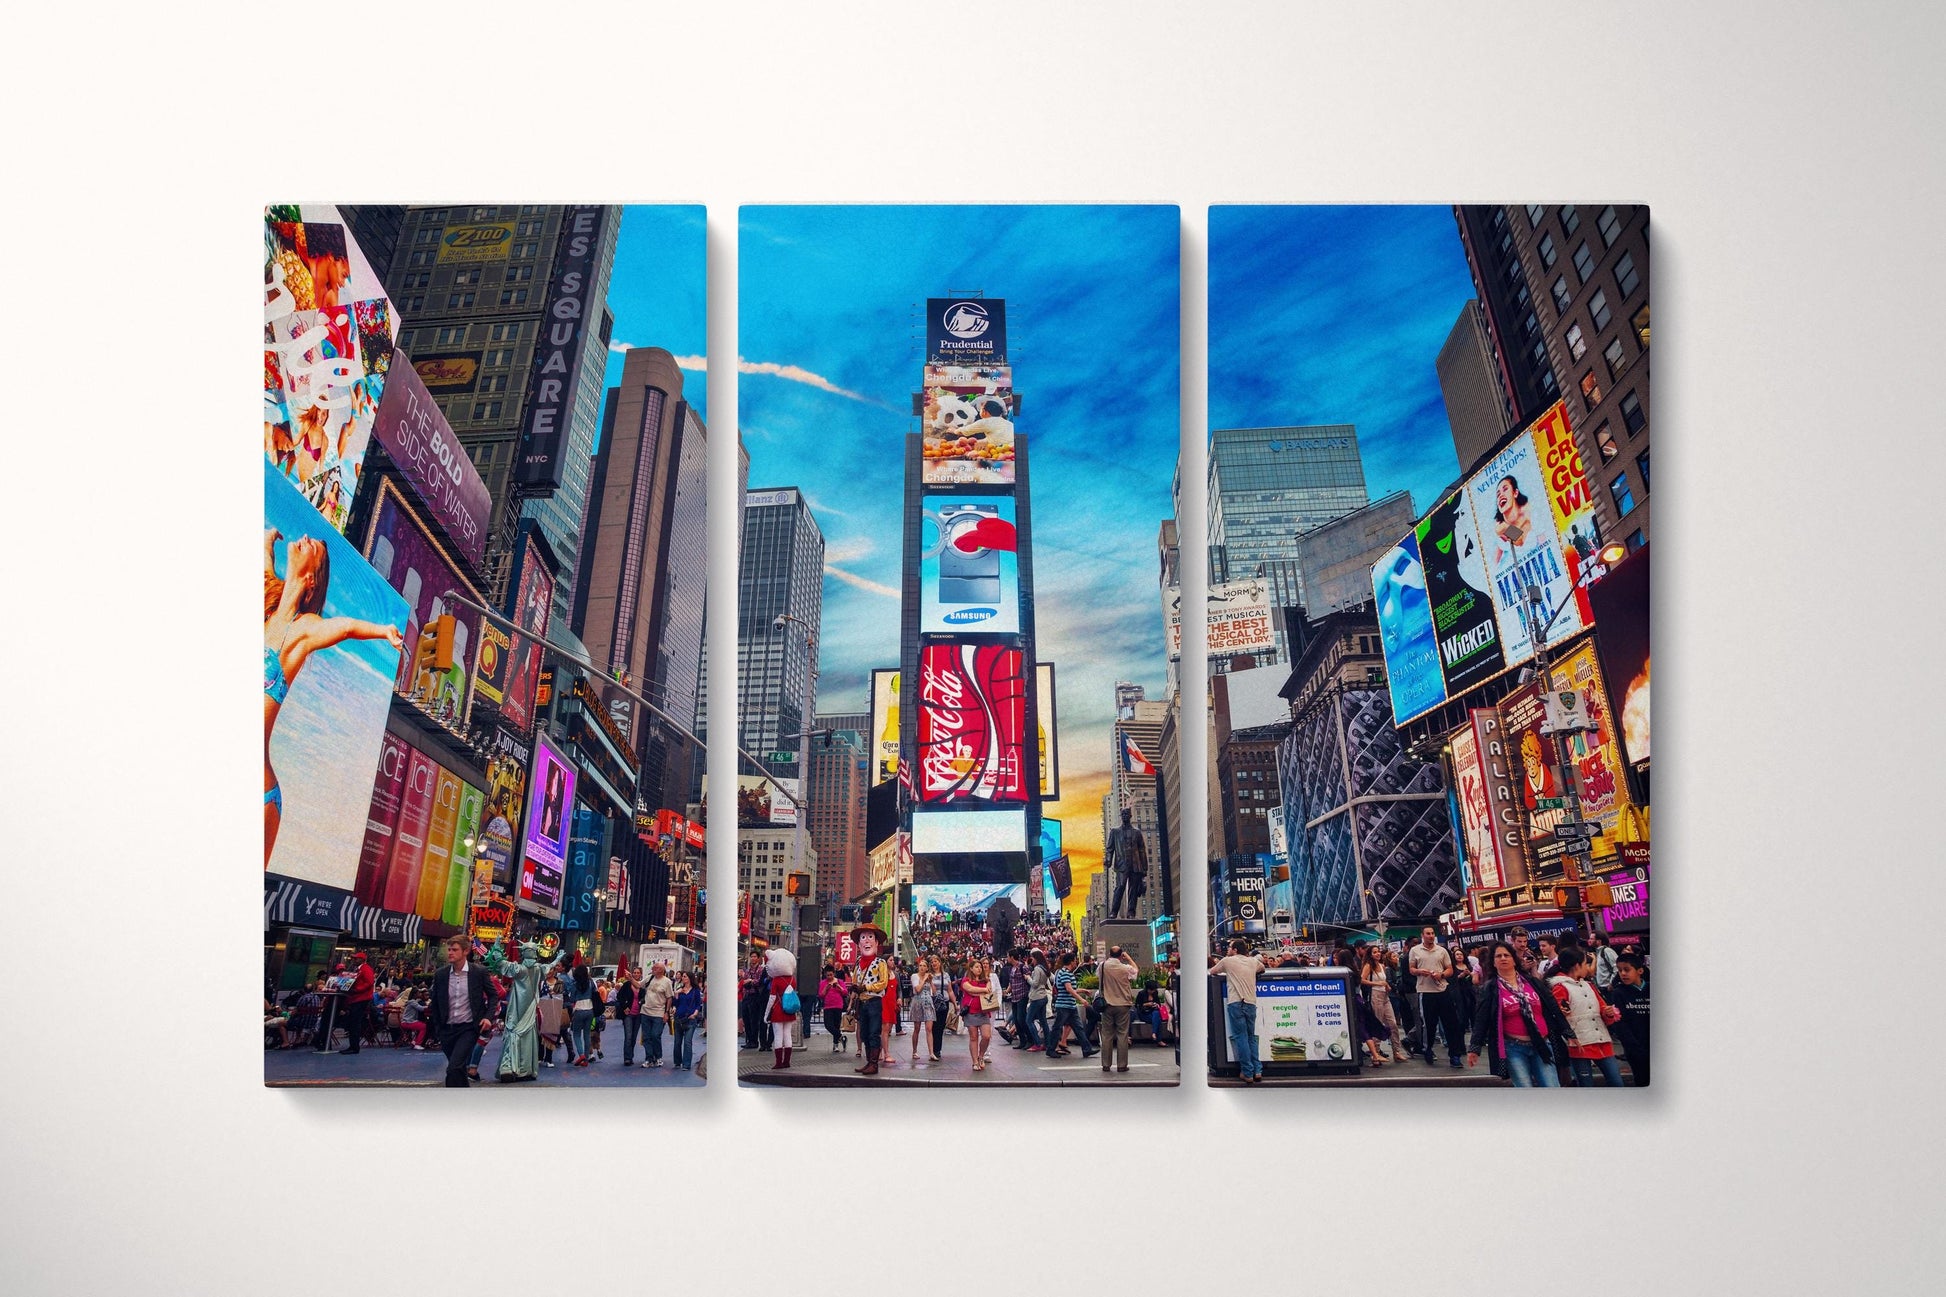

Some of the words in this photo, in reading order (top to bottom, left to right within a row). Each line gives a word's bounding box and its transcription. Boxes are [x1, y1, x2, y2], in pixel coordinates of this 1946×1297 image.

[450, 228, 505, 247] Z100
[568, 205, 599, 257] ES
[940, 339, 993, 349] Prudential
[532, 272, 582, 433] SQUARE
[406, 388, 432, 441] THE
[430, 430, 462, 486] BOLD
[1286, 437, 1350, 451] BARCLAYS
[525, 454, 549, 464] NYC
[1484, 461, 1499, 477] THE
[1499, 447, 1514, 463] FUN
[925, 473, 977, 483] Chengdu,
[1477, 471, 1500, 493] NEVER
[1499, 448, 1527, 474] STOPS!
[397, 419, 428, 475] SIDE
[428, 463, 446, 493] OF
[445, 483, 478, 545] WATER
[950, 612, 991, 620] SAMSUNG
[1208, 615, 1224, 623] EST
[1226, 610, 1267, 621] MUSICAL
[1232, 617, 1268, 631] BEST
[1253, 626, 1269, 636] OF
[480, 636, 498, 680] Q
[1392, 649, 1435, 684] PHANTOM
[1401, 680, 1432, 704] OPERA
[501, 736, 514, 753] JOY
[513, 741, 529, 762] RIDE!
[378, 742, 406, 783] ICE
[776, 753, 784, 761] 46
[409, 760, 434, 798] ICE
[1485, 719, 1519, 846] PALACE
[437, 777, 459, 811] ICE
[1537, 800, 1544, 808] W
[1546, 800, 1554, 808] 46
[1237, 877, 1265, 892] HERO
[1611, 886, 1637, 904] IMES
[316, 907, 329, 916] OPEN
[317, 900, 332, 909] WE'RE
[1611, 900, 1648, 921] SQUARE
[391, 917, 403, 926] WE'RE
[388, 925, 400, 934] OPEN
[1462, 936, 1470, 944] BOX
[1470, 934, 1482, 943] OFFICE
[1482, 933, 1494, 941] HERE
[1270, 984, 1295, 992] Green
[1297, 983, 1312, 991] and
[1315, 1003, 1341, 1011] recycle
